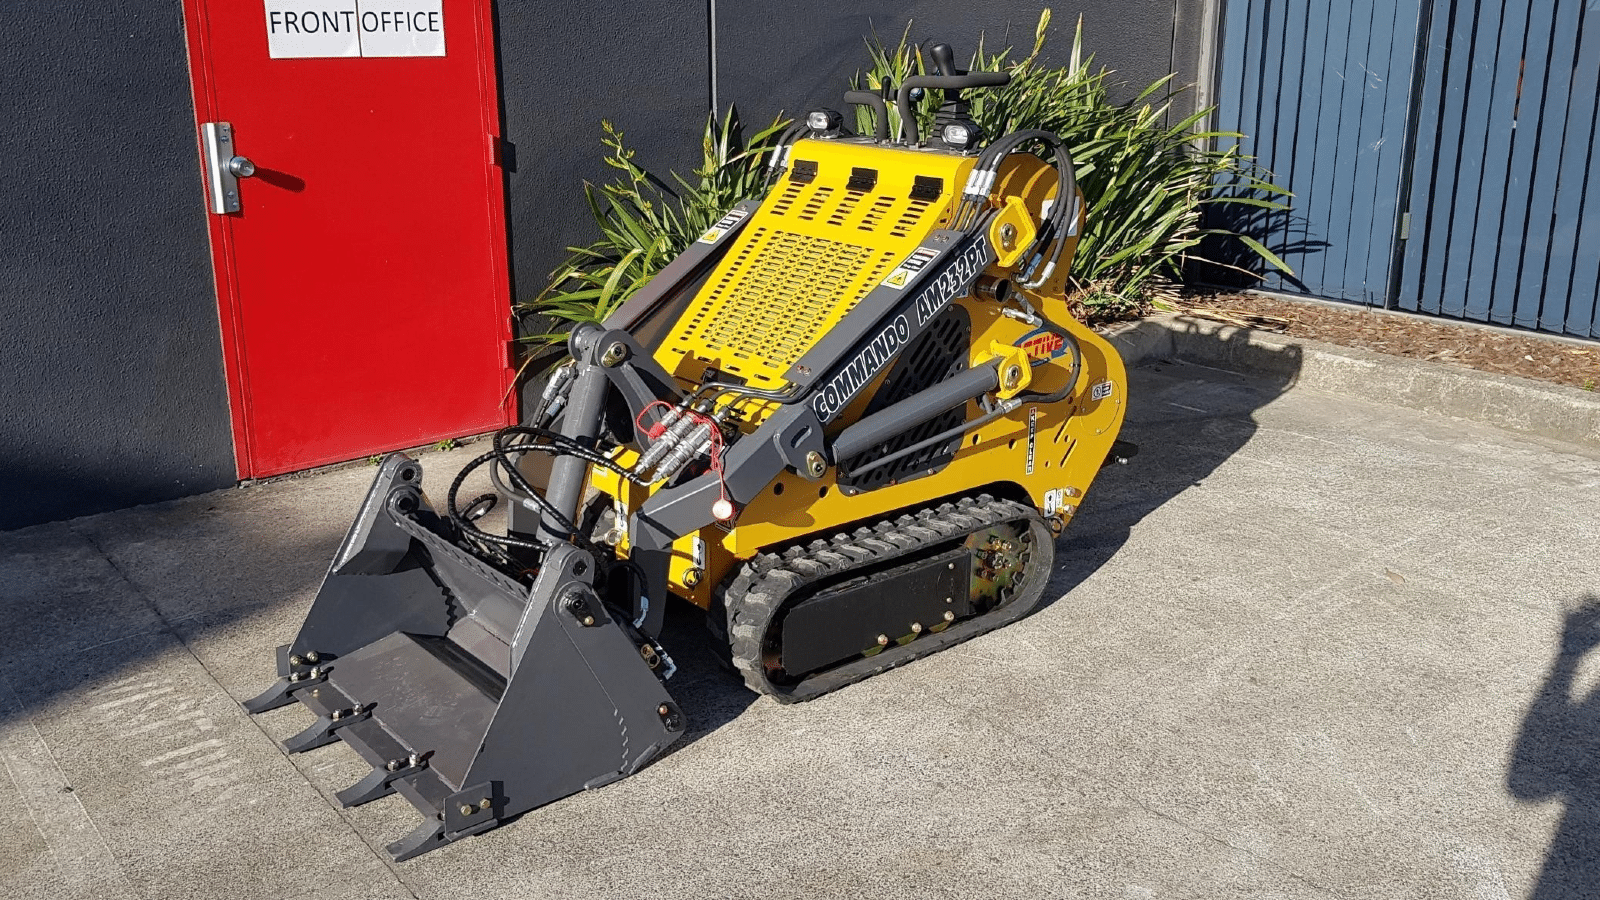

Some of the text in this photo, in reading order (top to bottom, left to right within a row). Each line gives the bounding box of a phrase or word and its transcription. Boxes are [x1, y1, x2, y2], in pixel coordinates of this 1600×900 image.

[269, 11, 440, 34] FRONT OFFICE
[813, 235, 987, 423] COMMANDO AM232PT
